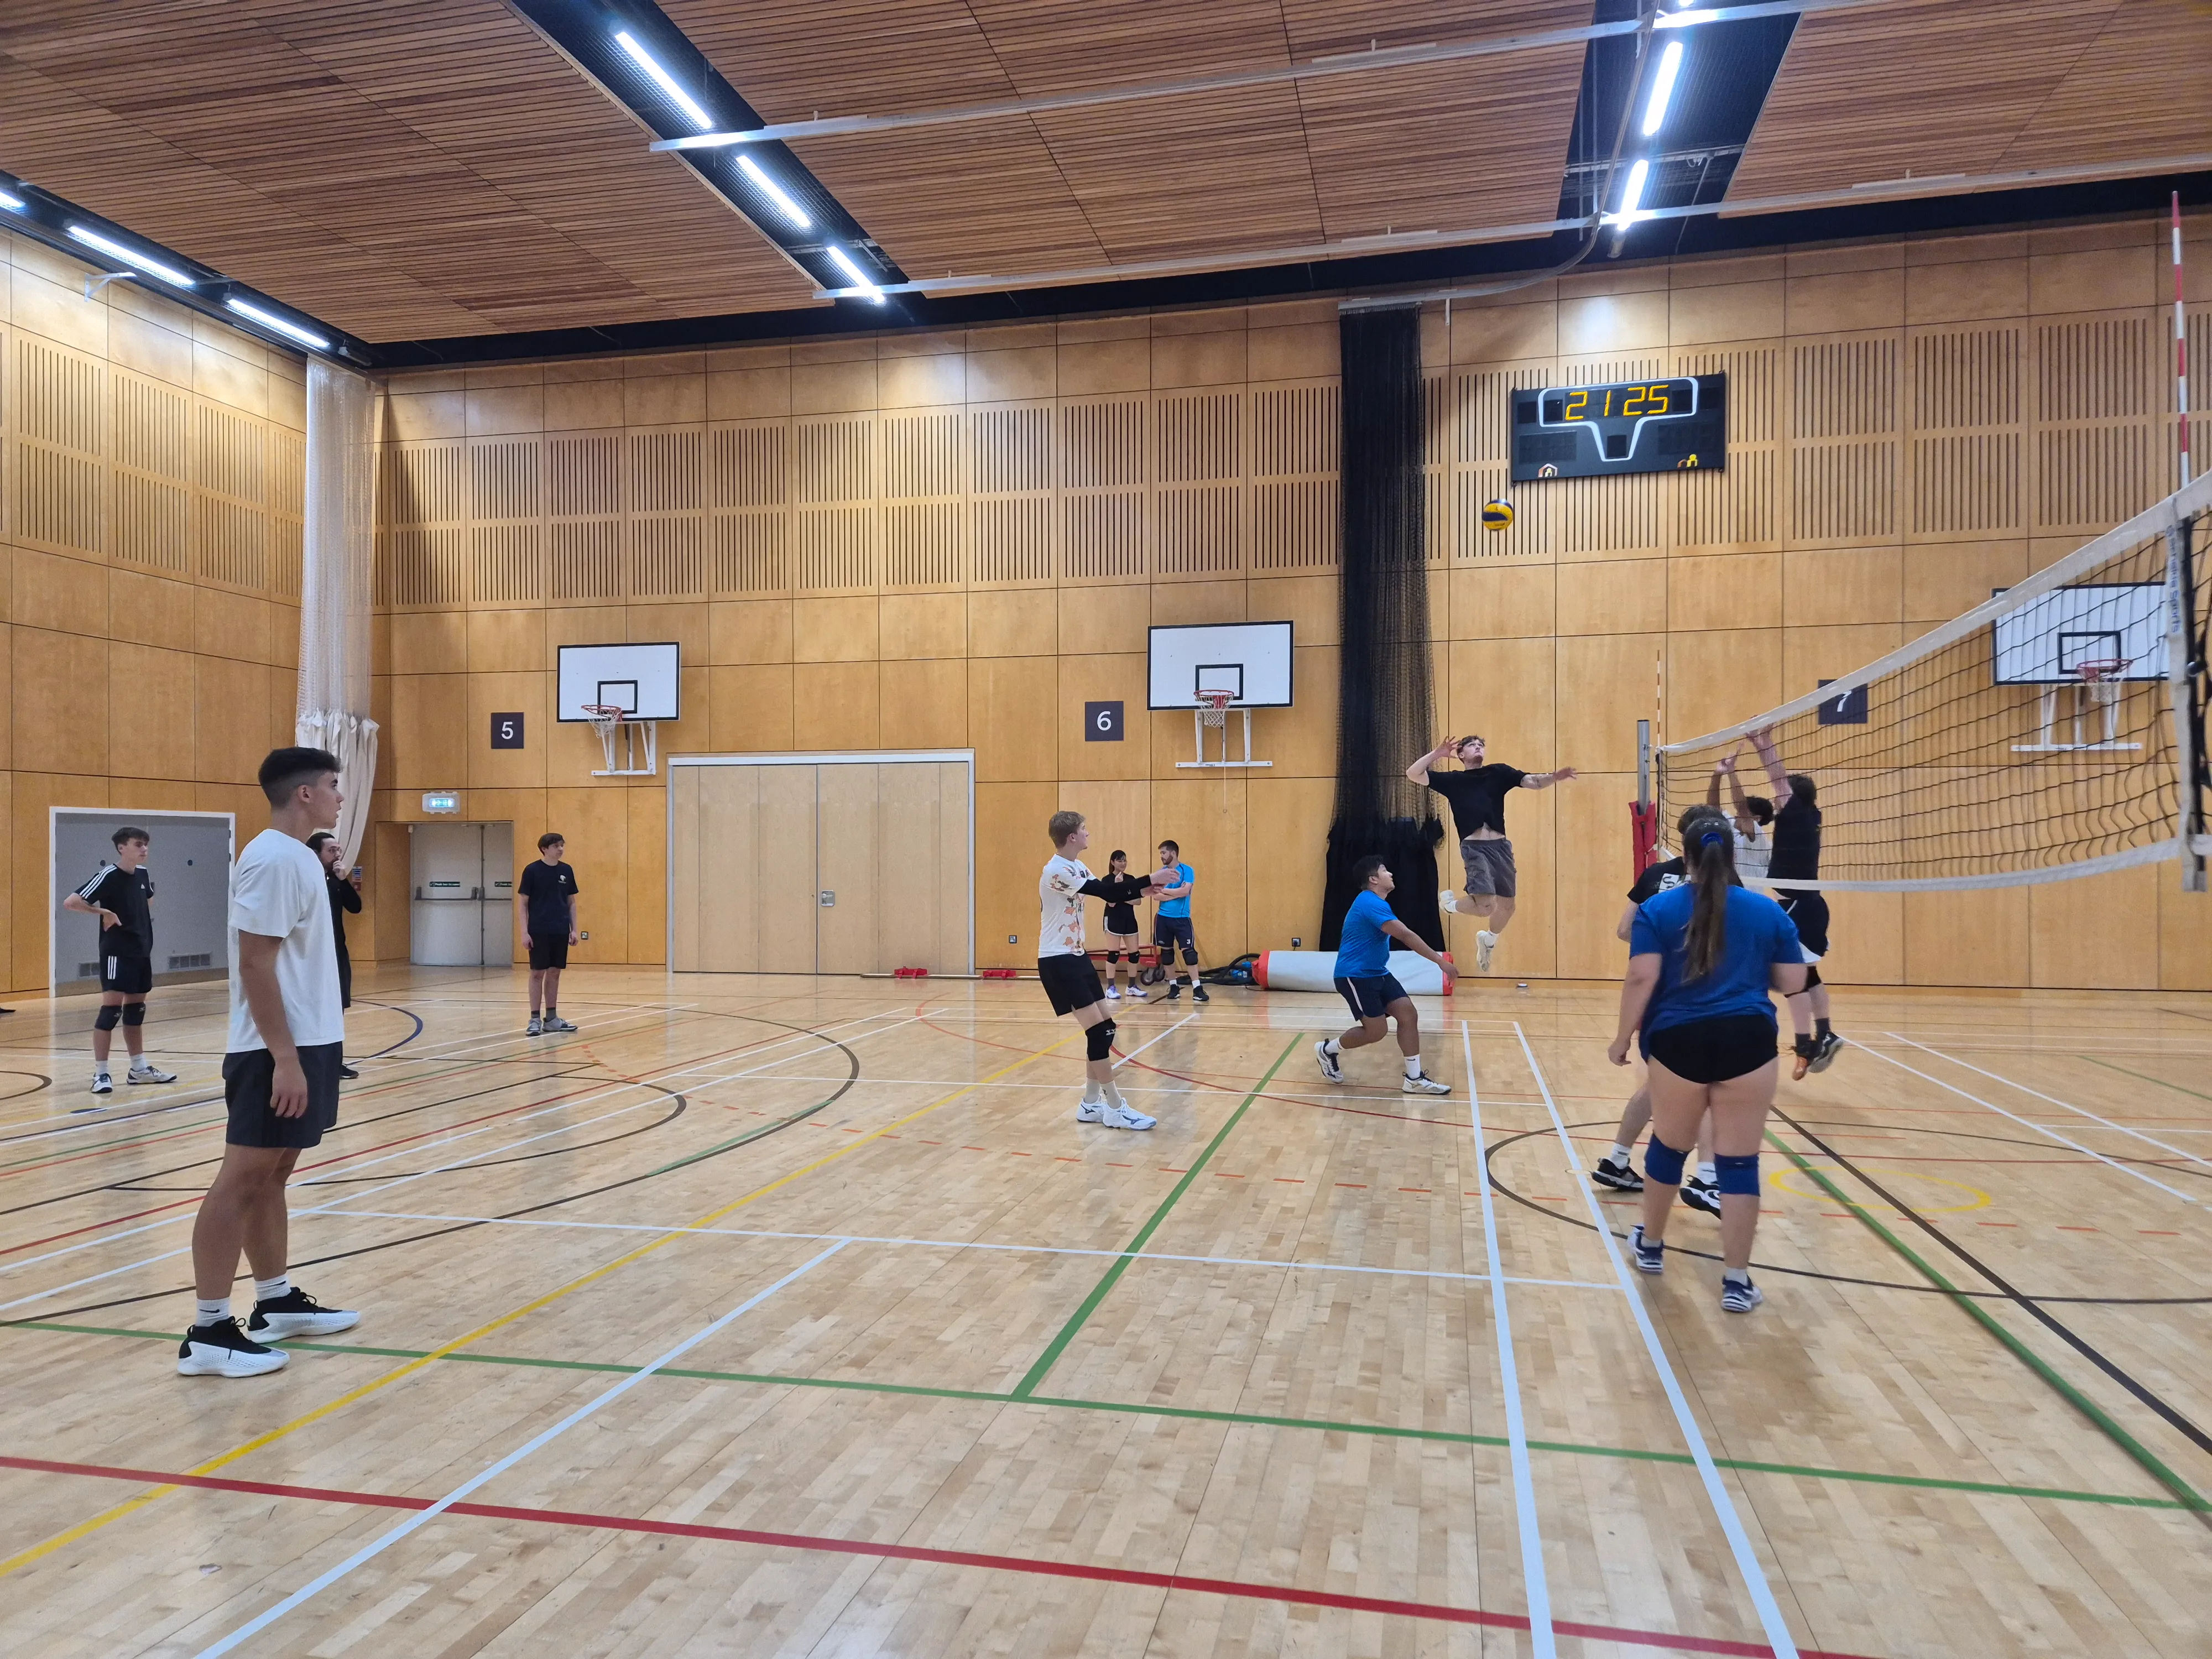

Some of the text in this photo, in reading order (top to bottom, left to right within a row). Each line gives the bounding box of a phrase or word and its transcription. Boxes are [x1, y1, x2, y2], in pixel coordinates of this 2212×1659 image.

[1623, 384, 1670, 416] 25
[1837, 690, 1852, 712] 7
[501, 721, 513, 739] 5
[1097, 711, 1112, 731] 6
